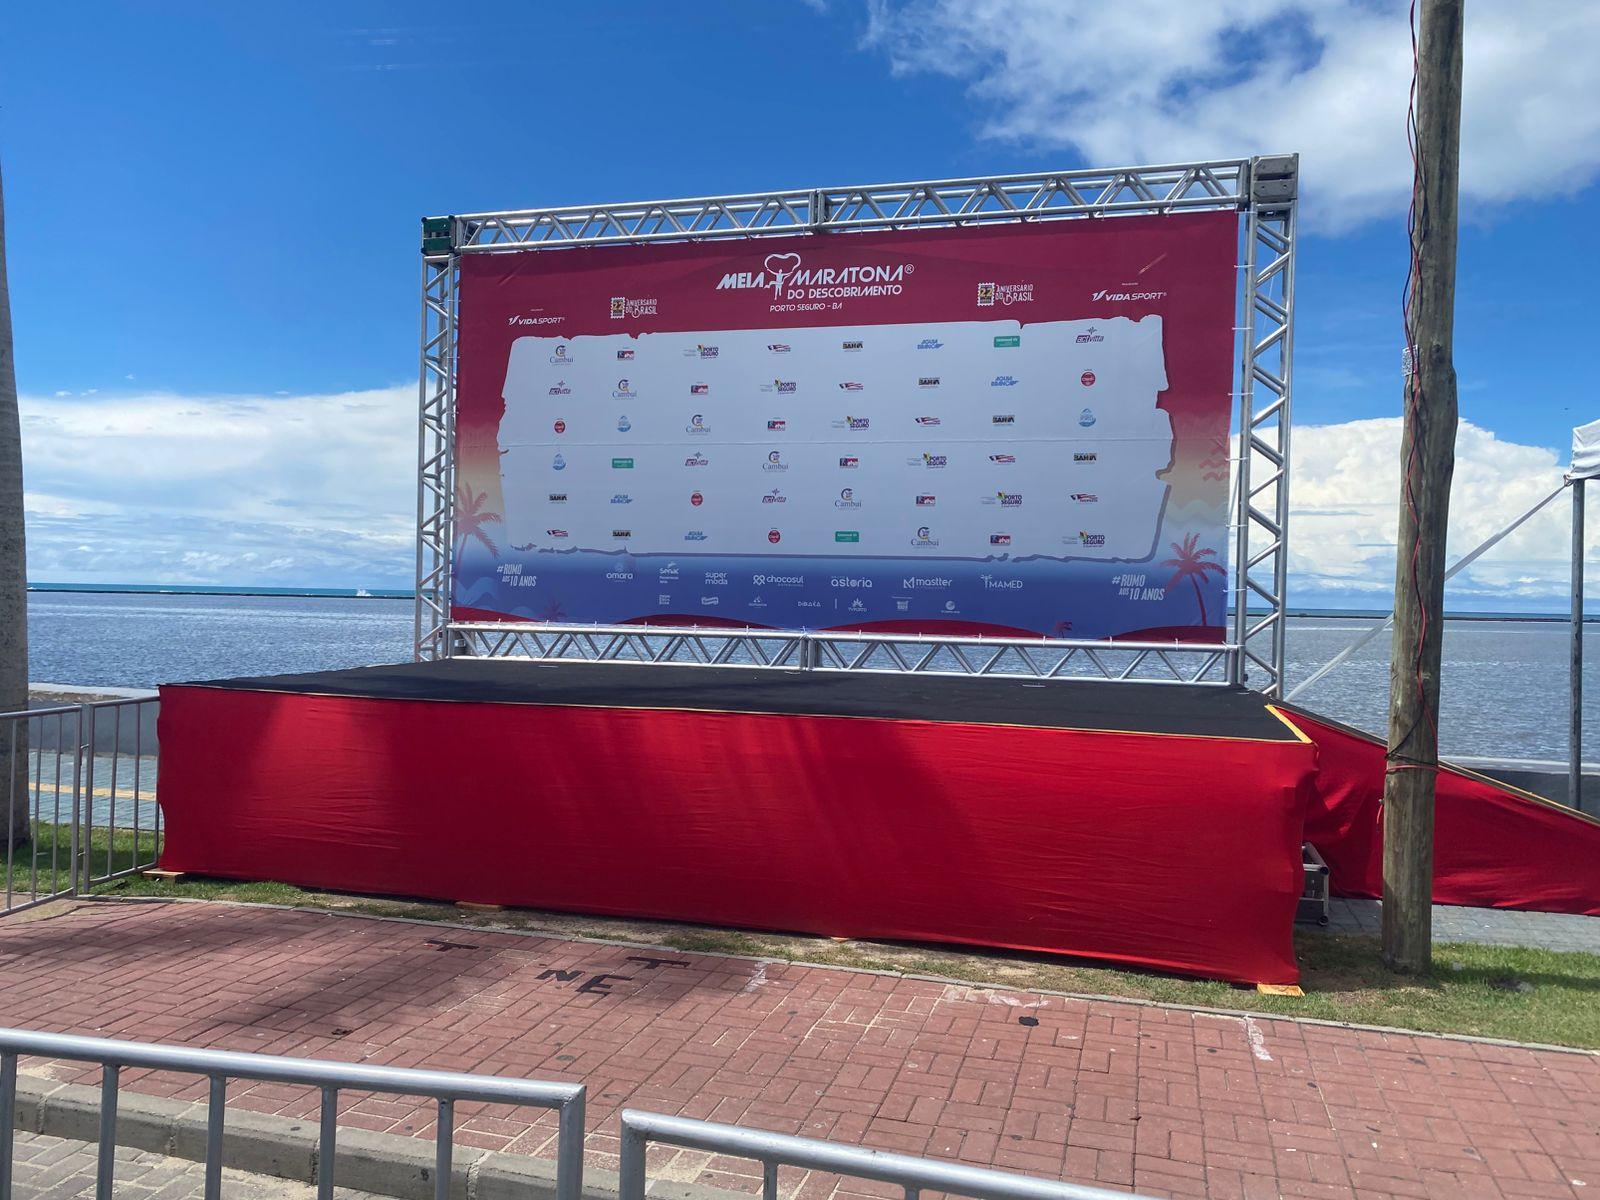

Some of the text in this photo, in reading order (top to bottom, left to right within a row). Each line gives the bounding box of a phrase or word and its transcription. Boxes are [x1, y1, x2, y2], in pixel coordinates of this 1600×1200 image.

[715, 272, 766, 290] MEIA
[787, 284, 903, 300] DO DESCOBRIMENTO
[1003, 290, 1034, 306] BRASIL
[632, 304, 658, 318] BRASIL
[769, 304, 796, 313] PORTO
[797, 302, 826, 312] SEGURO
[832, 302, 843, 310] BA
[519, 575, 537, 587] ANOS
[705, 571, 728, 579] super
[705, 577, 728, 585] moda
[766, 575, 804, 584] chocosul
[1130, 587, 1141, 600] 10
[1141, 587, 1166, 601] ANOS
